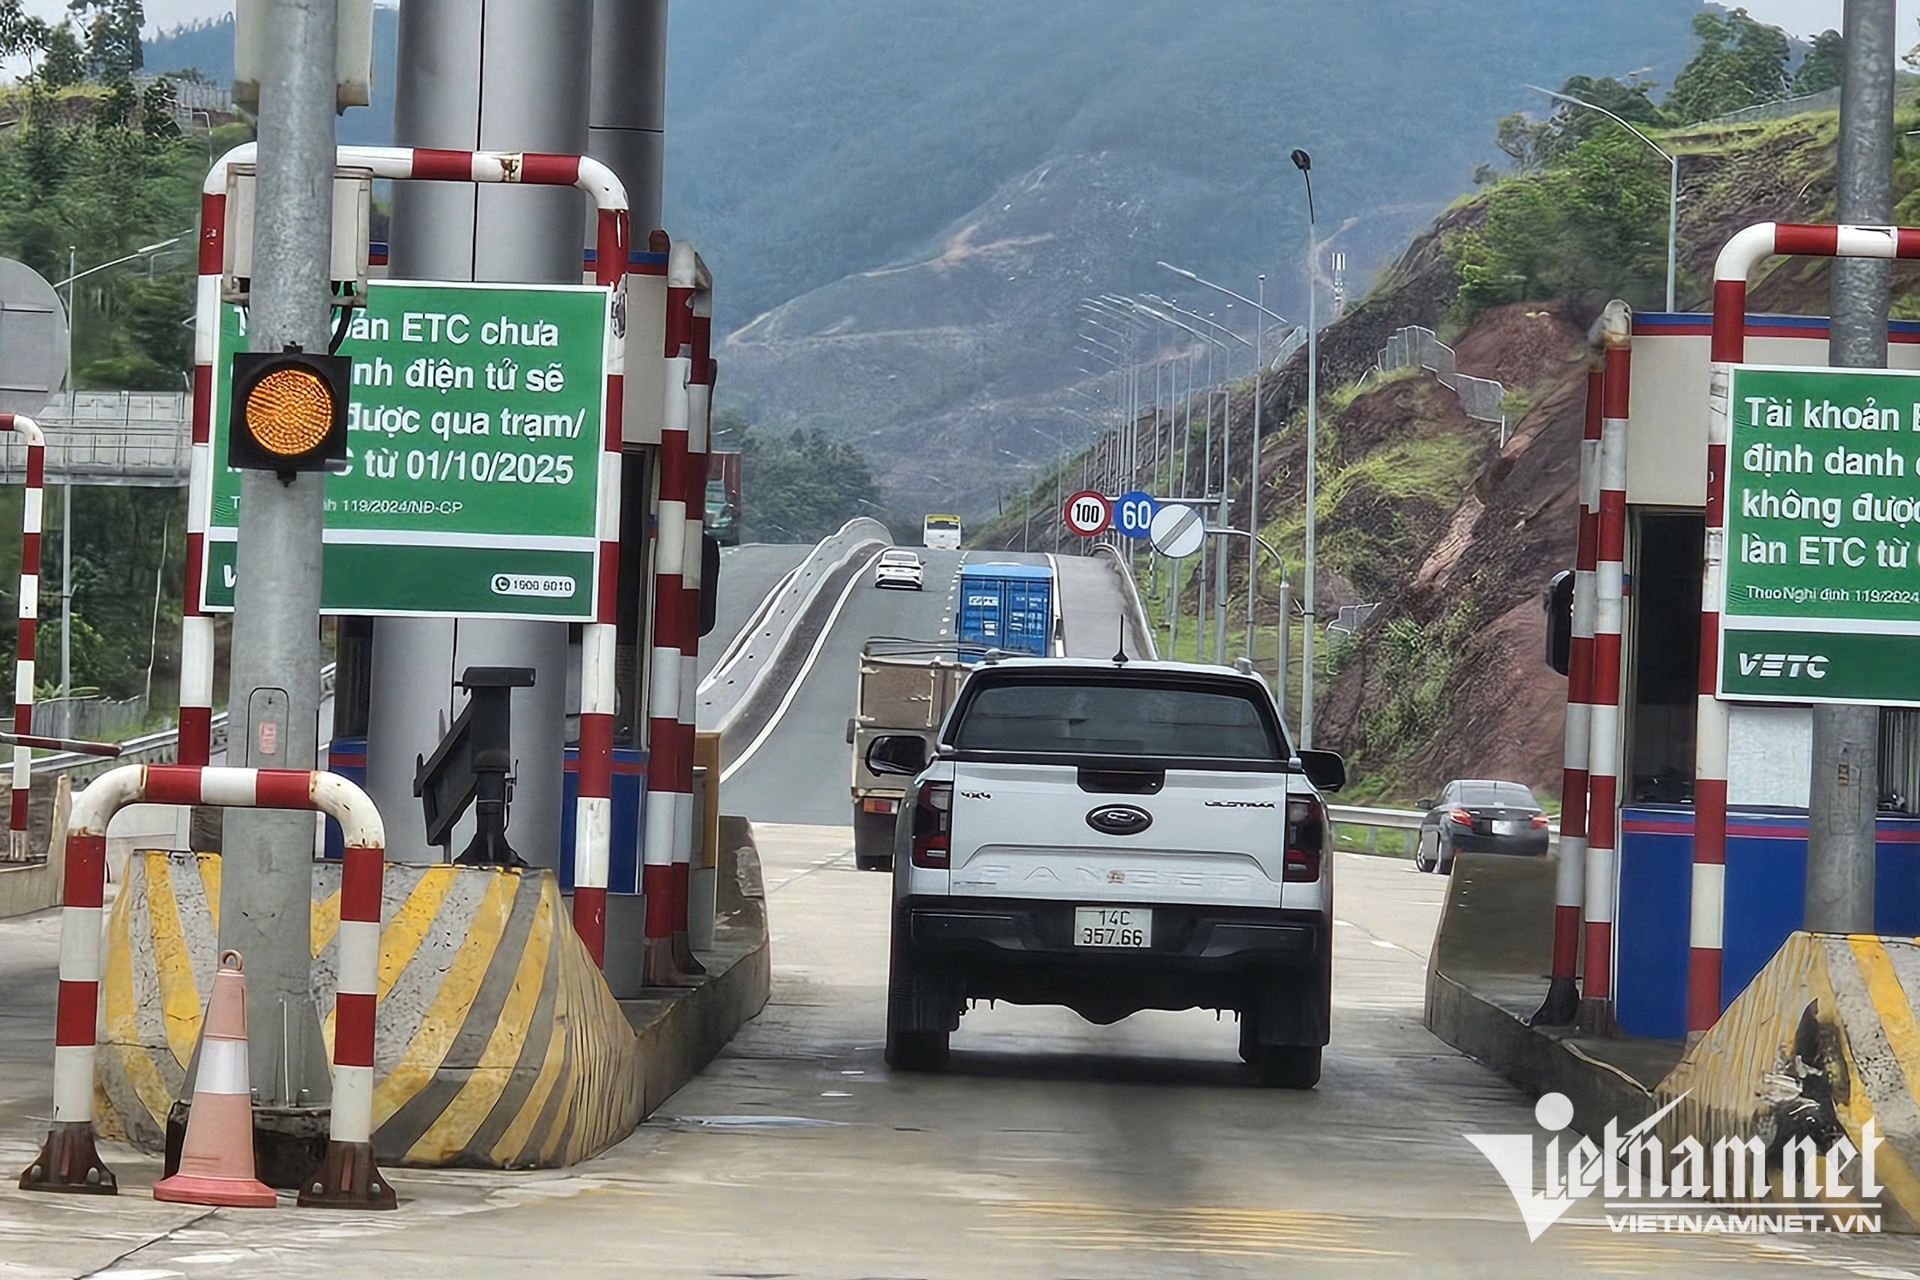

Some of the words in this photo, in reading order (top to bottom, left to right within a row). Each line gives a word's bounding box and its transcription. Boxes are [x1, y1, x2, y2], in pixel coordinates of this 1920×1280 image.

[402, 312, 470, 344] ETC
[481, 316, 558, 347] chưa
[405, 357, 474, 394] điện
[486, 358, 519, 391] tử
[525, 363, 564, 393] sẽ
[431, 411, 490, 441] qua
[500, 408, 586, 442] trạm/
[1744, 396, 1793, 428] Tài
[1804, 396, 1900, 432] khoản
[365, 448, 399, 478] từ
[407, 450, 574, 485] 01/10/2025
[1743, 444, 1814, 478] định
[1824, 445, 1905, 477] danh
[342, 500, 463, 515] 119/2024/NĐ-CP
[1075, 503, 1100, 524] 100
[1122, 500, 1152, 530] 60
[1742, 488, 1841, 529] không
[1741, 533, 1787, 565] làn
[1799, 536, 1867, 568] ETC
[1876, 538, 1911, 568] từ
[1739, 652, 1830, 679] VETC
[1099, 910, 1131, 926] 14C
[1083, 928, 1143, 946] 357.66
